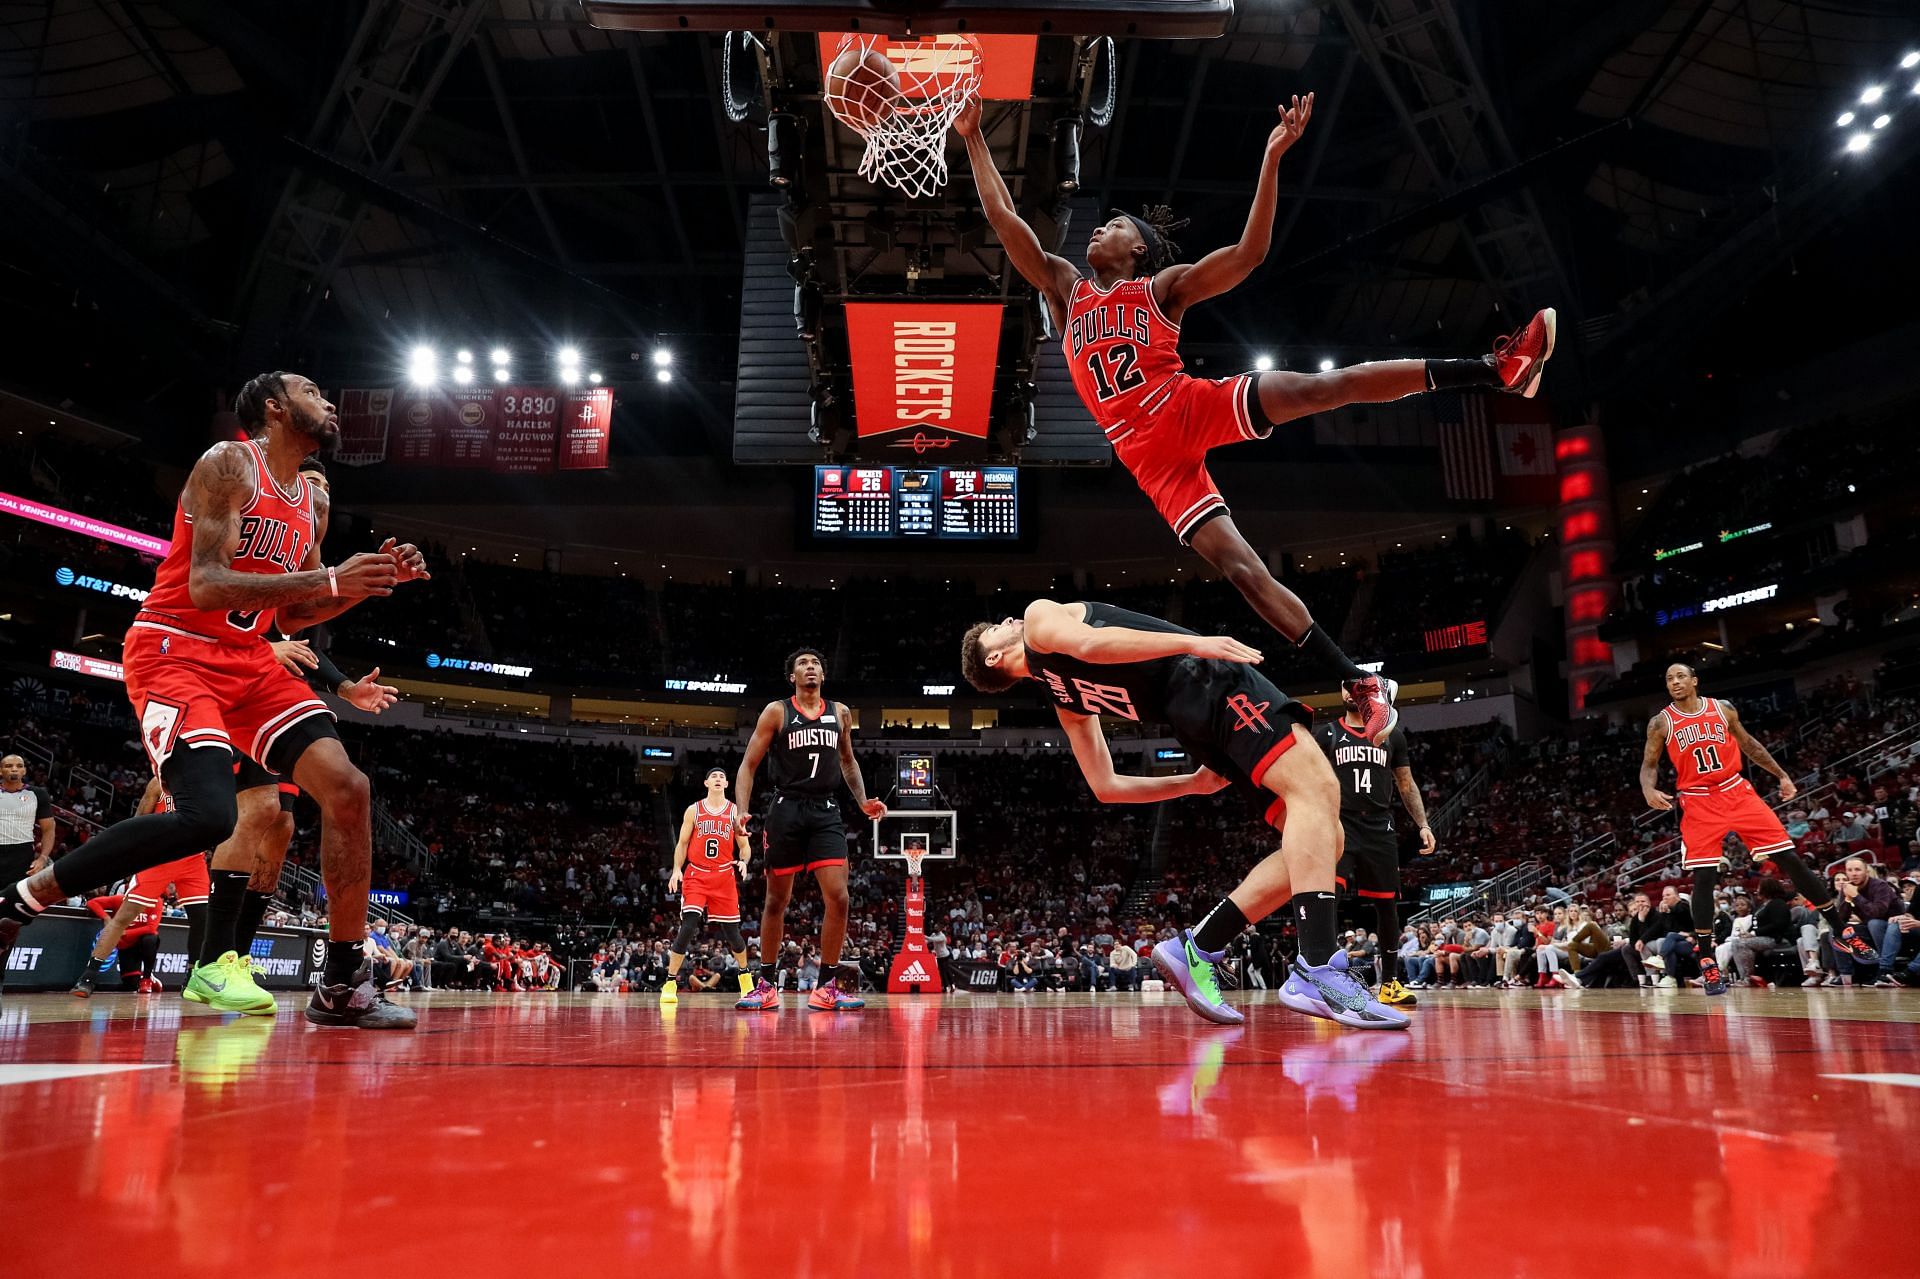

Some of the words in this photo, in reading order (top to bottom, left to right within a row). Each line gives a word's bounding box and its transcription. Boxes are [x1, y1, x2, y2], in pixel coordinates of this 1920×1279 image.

[1071, 303, 1150, 361] BULLS
[893, 321, 957, 420] ROCKETS
[1087, 343, 1147, 402] 12
[862, 478, 881, 491] 26
[955, 479, 974, 492] 25
[19, 504, 56, 521] VEHICLE
[56, 514, 69, 523] OF
[70, 517, 86, 529] THE
[86, 522, 126, 541] HOUSTON
[126, 535, 162, 551] ROCKETS
[1720, 522, 1772, 542] DRAFTKINGS
[75, 575, 112, 592] AT&T
[1702, 584, 1778, 613] SPORTSNET
[441, 658, 470, 669] AT&T
[469, 661, 533, 678] SPORTSNET
[687, 681, 747, 693] SPORTSNET
[923, 685, 955, 695] TSNET
[788, 728, 838, 750] HOUSTON
[1674, 721, 1726, 753] BULLS
[808, 752, 820, 779] 7
[1335, 745, 1387, 768] HOUSTON
[1692, 744, 1724, 775] 11
[911, 769, 927, 787] 12
[1353, 768, 1372, 794] 14
[696, 818, 732, 841] BULLS
[705, 838, 719, 859] 6
[368, 893, 400, 904] ULTRA
[1430, 888, 1450, 900] LIGHT
[5, 947, 44, 971] NET
[899, 974, 931, 982] adidas
[969, 969, 998, 985] LIGH
